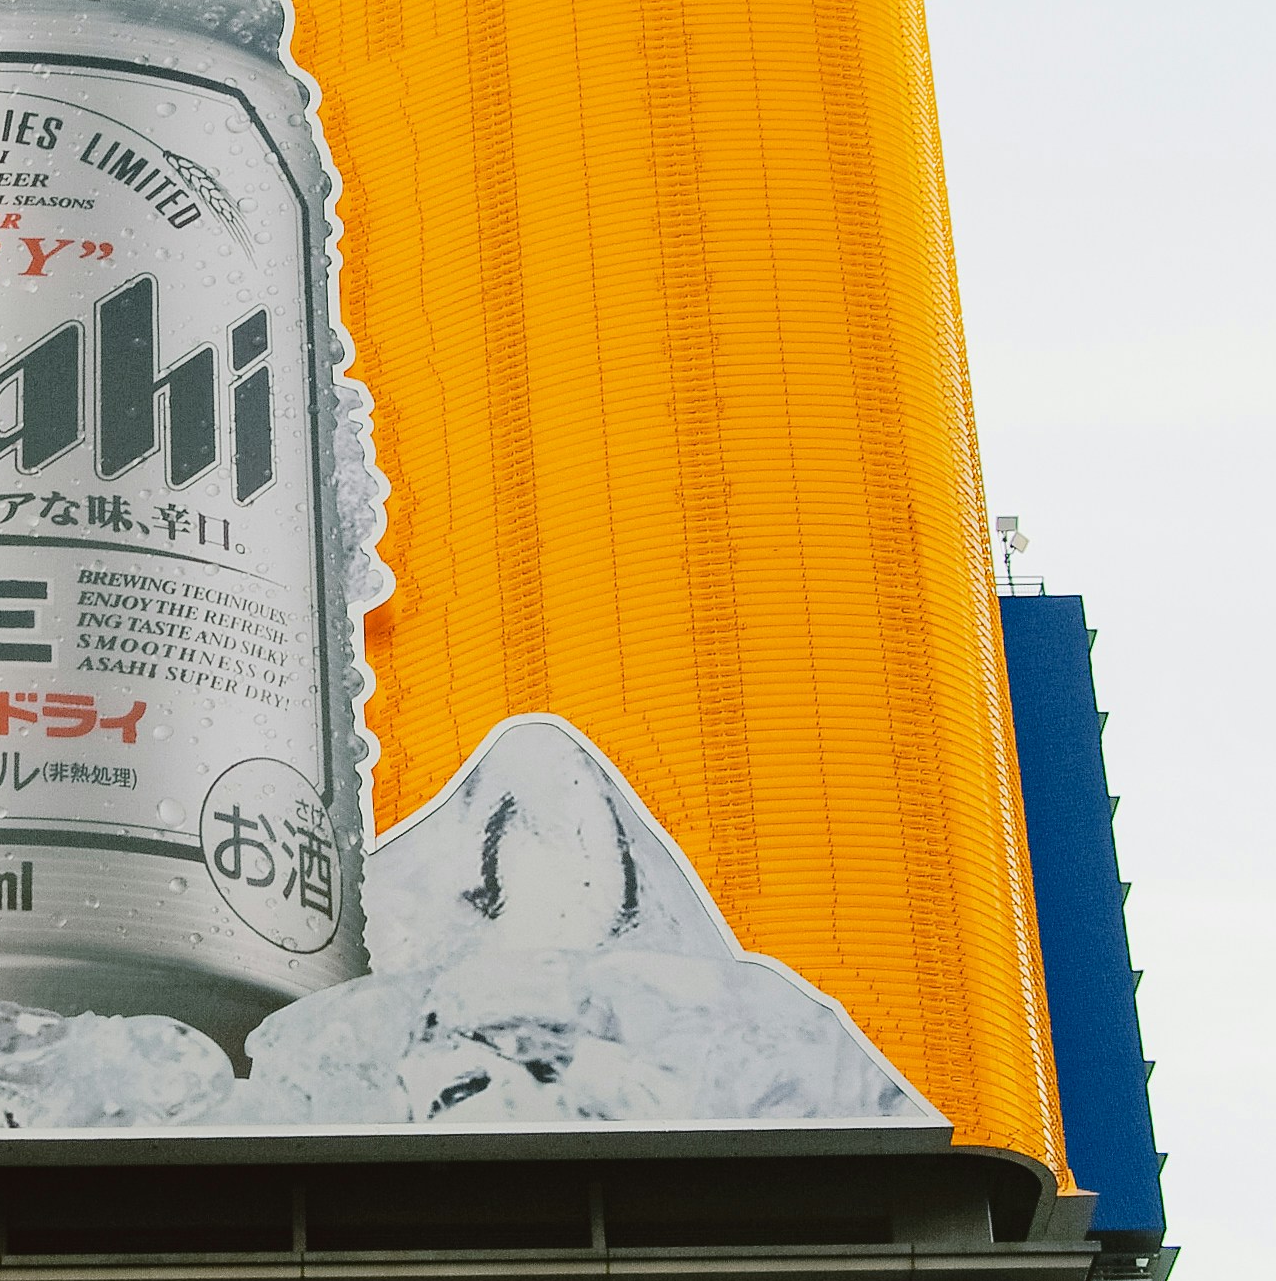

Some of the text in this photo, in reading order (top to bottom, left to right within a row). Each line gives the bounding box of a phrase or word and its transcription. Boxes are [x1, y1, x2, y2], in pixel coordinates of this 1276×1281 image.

[12, 194, 96, 211] SEASONS
[80, 131, 203, 231] LIMITED
[76, 569, 177, 595] BREWING
[76, 612, 289, 668] ING TASTE AND SILKY
[77, 591, 289, 645] ENJOY THE REFRESH-
[76, 633, 290, 688] SMOOTHNESS OF
[76, 656, 291, 712] ASAHI SUPER DRY!
[213, 804, 334, 922] お酒
